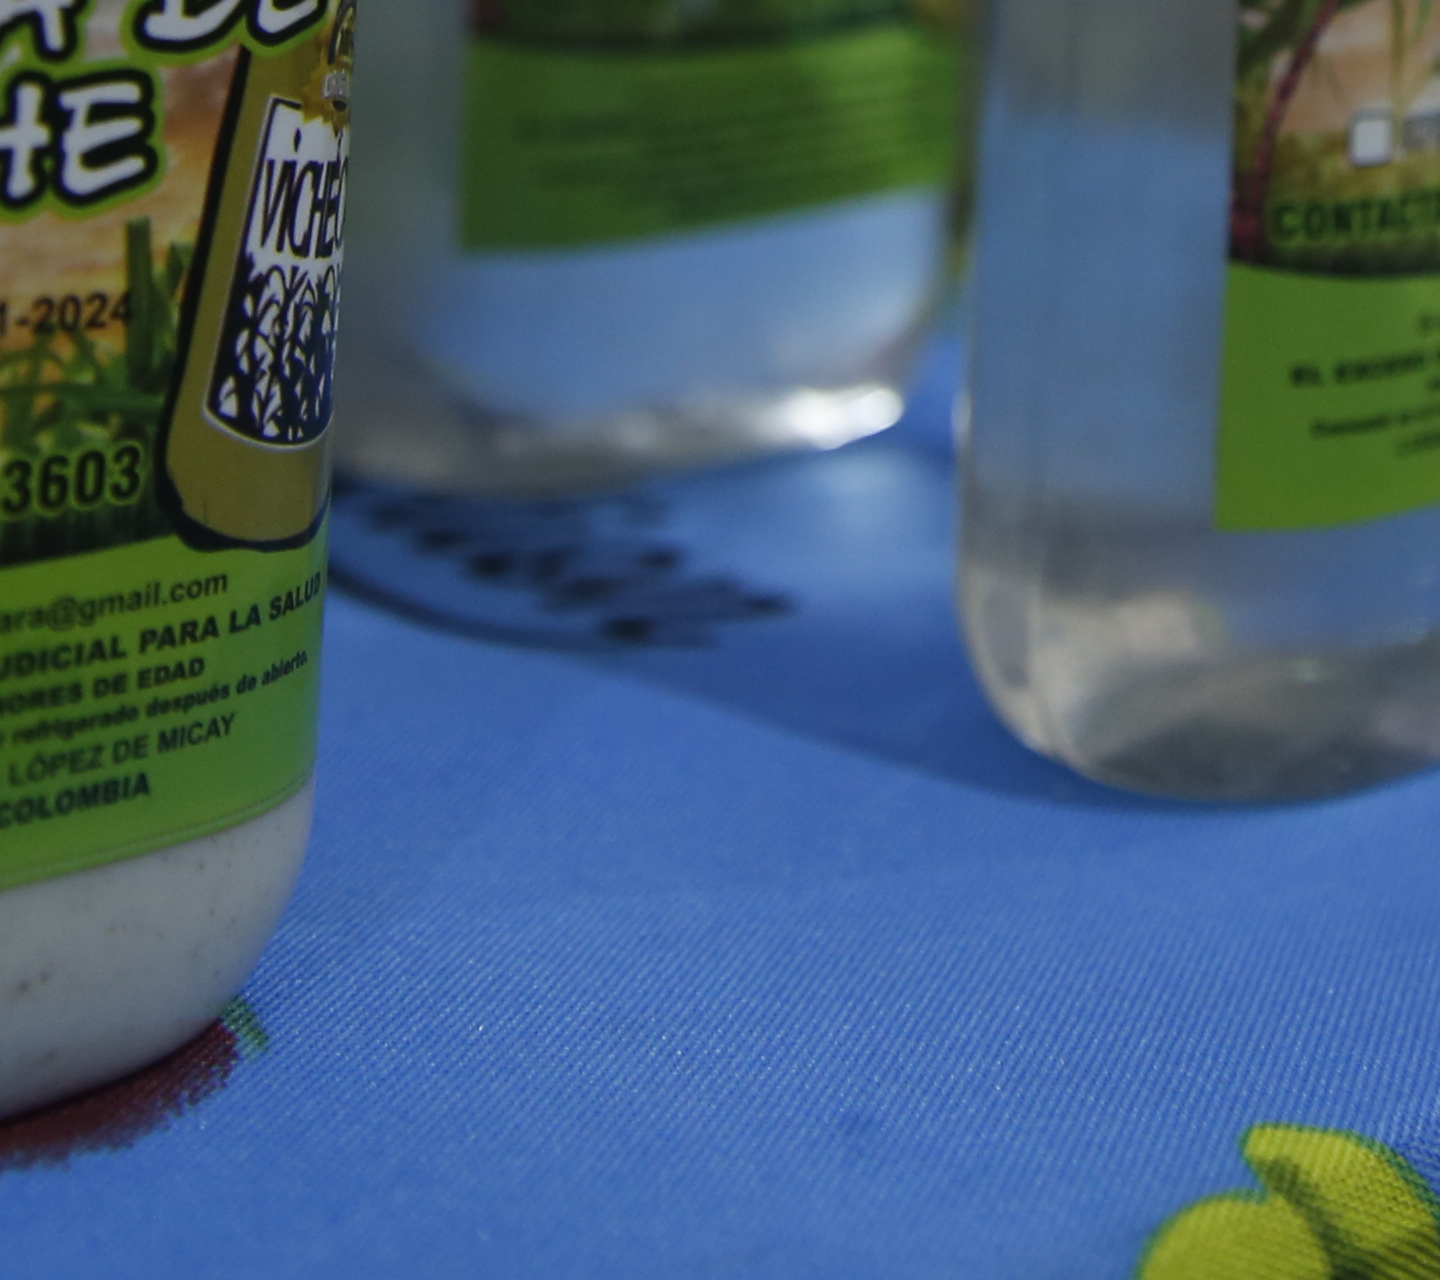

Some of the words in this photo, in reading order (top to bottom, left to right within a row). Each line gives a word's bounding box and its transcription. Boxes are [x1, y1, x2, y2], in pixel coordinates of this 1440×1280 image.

[0, 444, 143, 518] 3603
[139, 614, 220, 654] PARA
[228, 601, 262, 634] LA
[268, 570, 324, 620] SALUD
[11, 704, 139, 746] refrigerado
[145, 682, 230, 721] después
[236, 671, 258, 695] de
[93, 667, 129, 697] DE
[137, 655, 206, 689] EDAD
[8, 744, 105, 788] LÓPEZ
[112, 736, 149, 762] DE
[157, 712, 237, 754] MICAY
